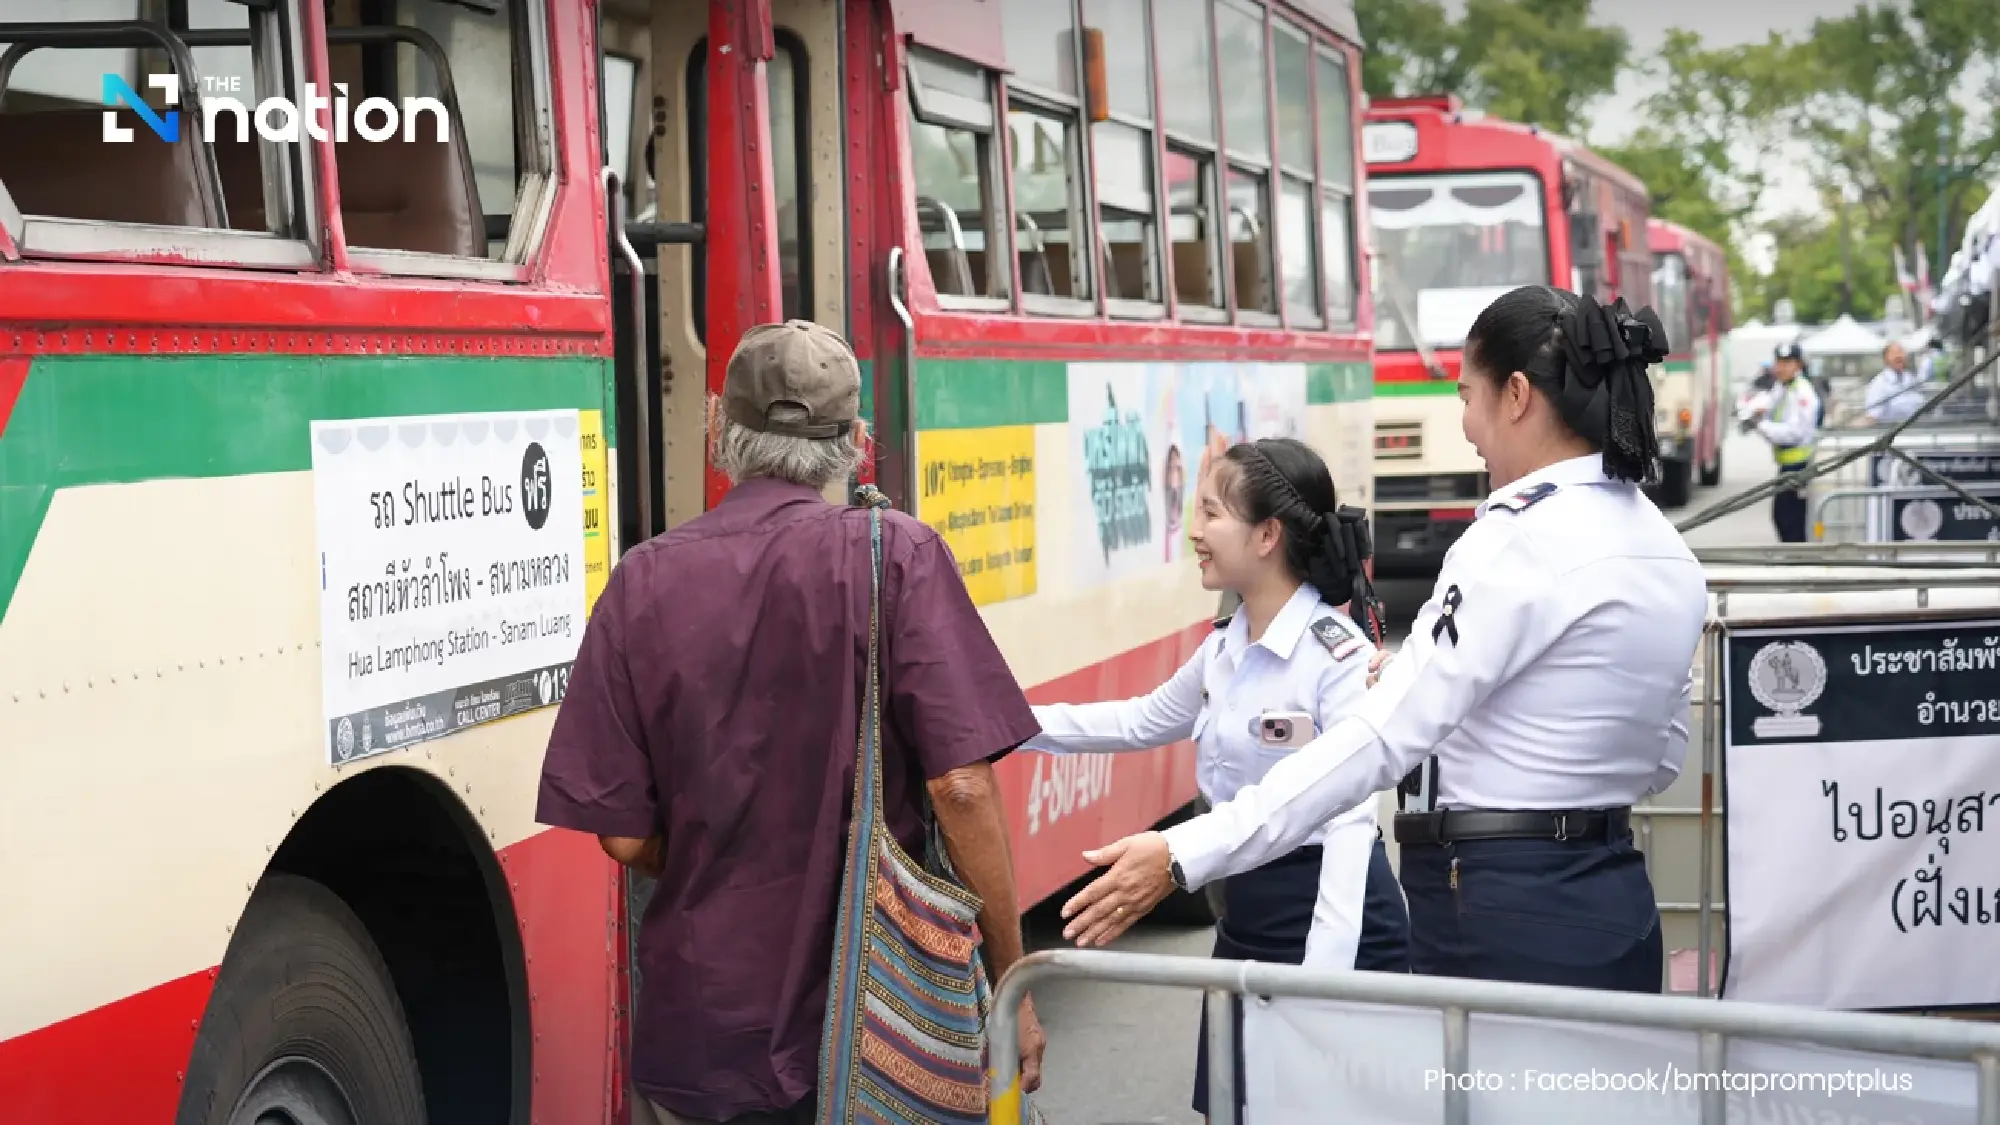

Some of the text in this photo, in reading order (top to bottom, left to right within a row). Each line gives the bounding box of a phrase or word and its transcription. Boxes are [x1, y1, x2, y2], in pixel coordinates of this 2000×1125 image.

[370, 457, 548, 529] รถ Shuttle Bus ฟรี
[923, 461, 946, 497] 107
[348, 551, 471, 621] สถานีหัวลำโพง
[489, 552, 569, 596] สนามหลวง
[348, 651, 372, 679] Hua
[377, 637, 443, 673] Lamphong
[448, 626, 488, 656] Station
[500, 620, 538, 645] Sanam
[540, 614, 571, 637] Luang
[1850, 636, 2000, 676] ประชาสัมพั
[1891, 853, 2000, 933] (ฝั่งเ
